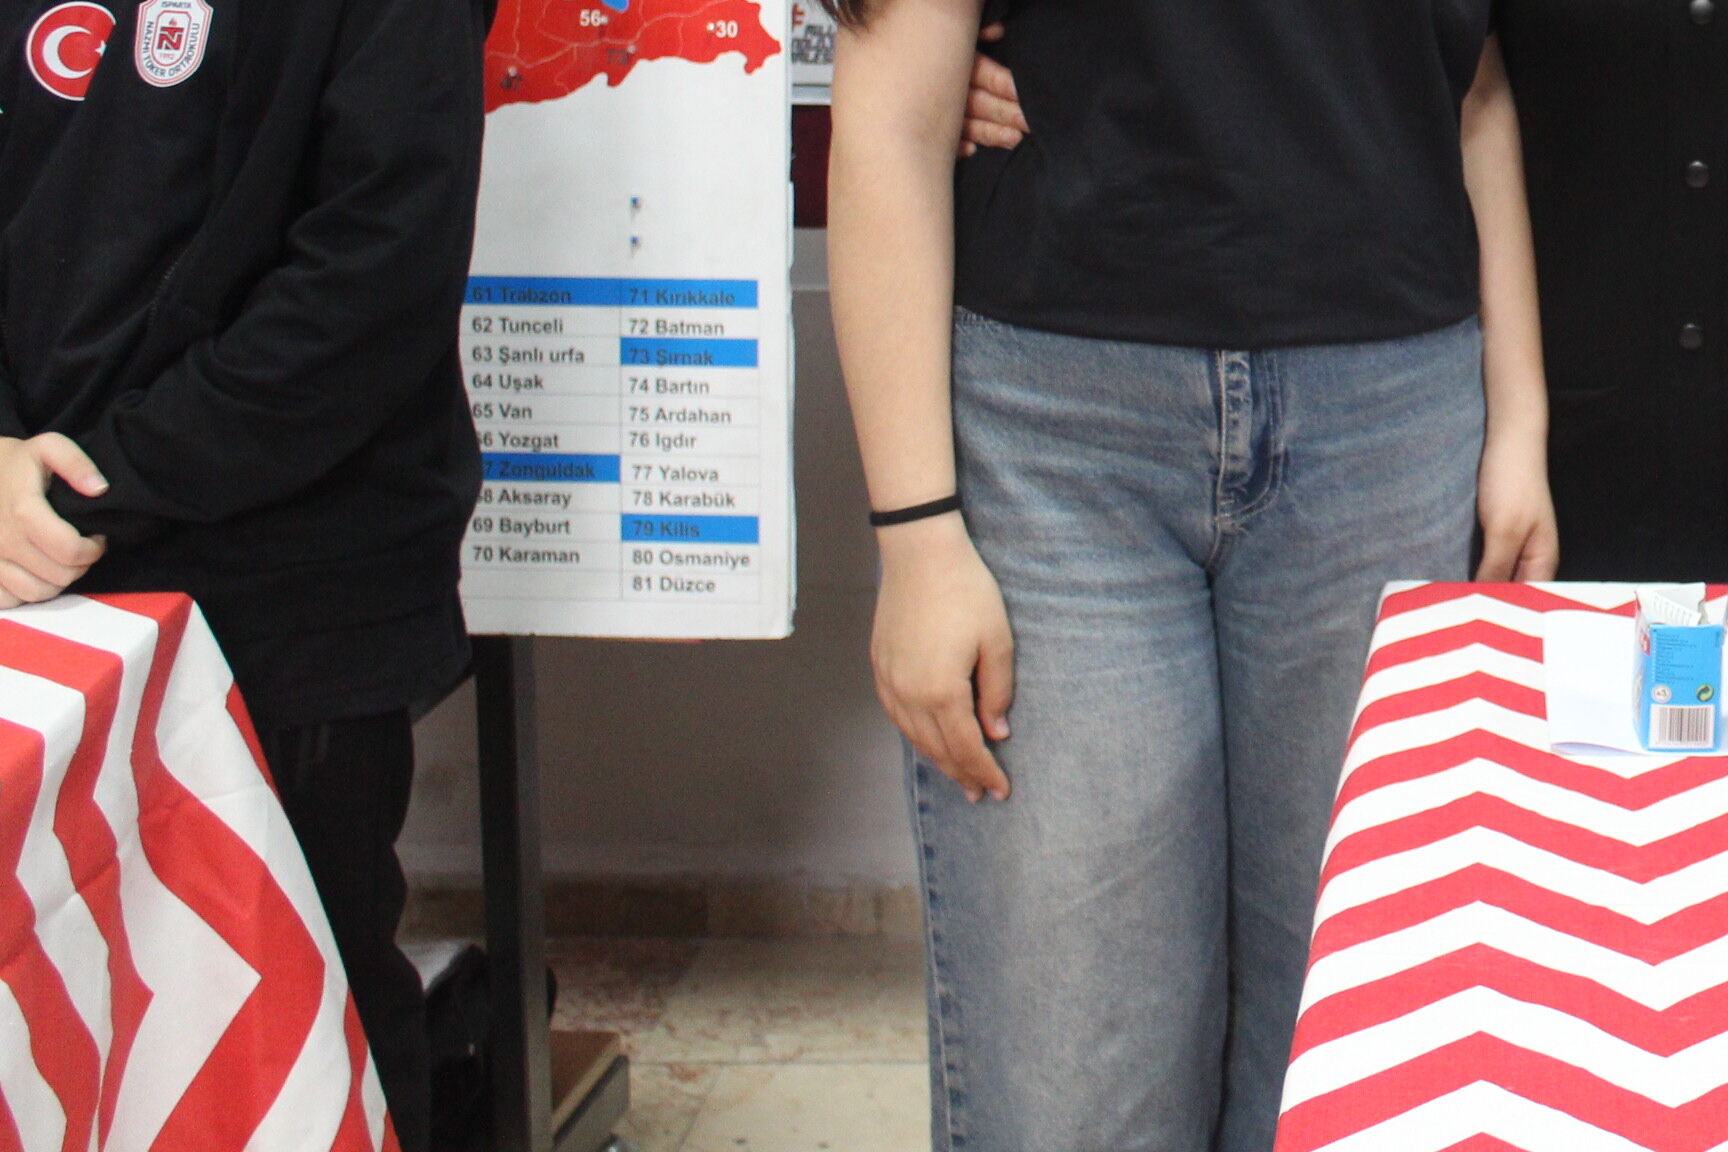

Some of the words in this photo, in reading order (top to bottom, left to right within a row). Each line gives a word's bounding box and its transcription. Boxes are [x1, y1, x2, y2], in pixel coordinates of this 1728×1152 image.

[580, 11, 601, 26] 56
[716, 21, 737, 37] 30
[473, 319, 492, 332] 62
[499, 319, 563, 334] Tunceli
[629, 321, 649, 334] 72
[656, 321, 724, 335] Batman
[473, 349, 492, 363] 63
[499, 349, 544, 365] Şanlı
[550, 350, 584, 364] urfa
[473, 376, 492, 389] 64
[499, 376, 544, 391] Uşak
[629, 379, 649, 392] 74
[656, 379, 710, 394] Bartın
[473, 405, 492, 418] 65
[499, 405, 532, 419] Van
[629, 409, 650, 422] 75
[656, 409, 732, 423] Ardahan
[499, 434, 558, 452] Yozgat
[629, 434, 650, 448] 76
[632, 466, 652, 479] 77
[659, 466, 719, 481] Yalova
[499, 491, 571, 509] Aksaray
[633, 492, 653, 506] 78
[659, 492, 735, 508] Karabük
[473, 520, 492, 533] 69
[499, 520, 570, 536] Bayburt
[473, 548, 492, 562] 70
[499, 548, 580, 563] Karaman
[633, 551, 653, 565] 80
[659, 551, 750, 569] Osmaniye
[633, 579, 652, 593] 81
[660, 579, 716, 593] Düzce
